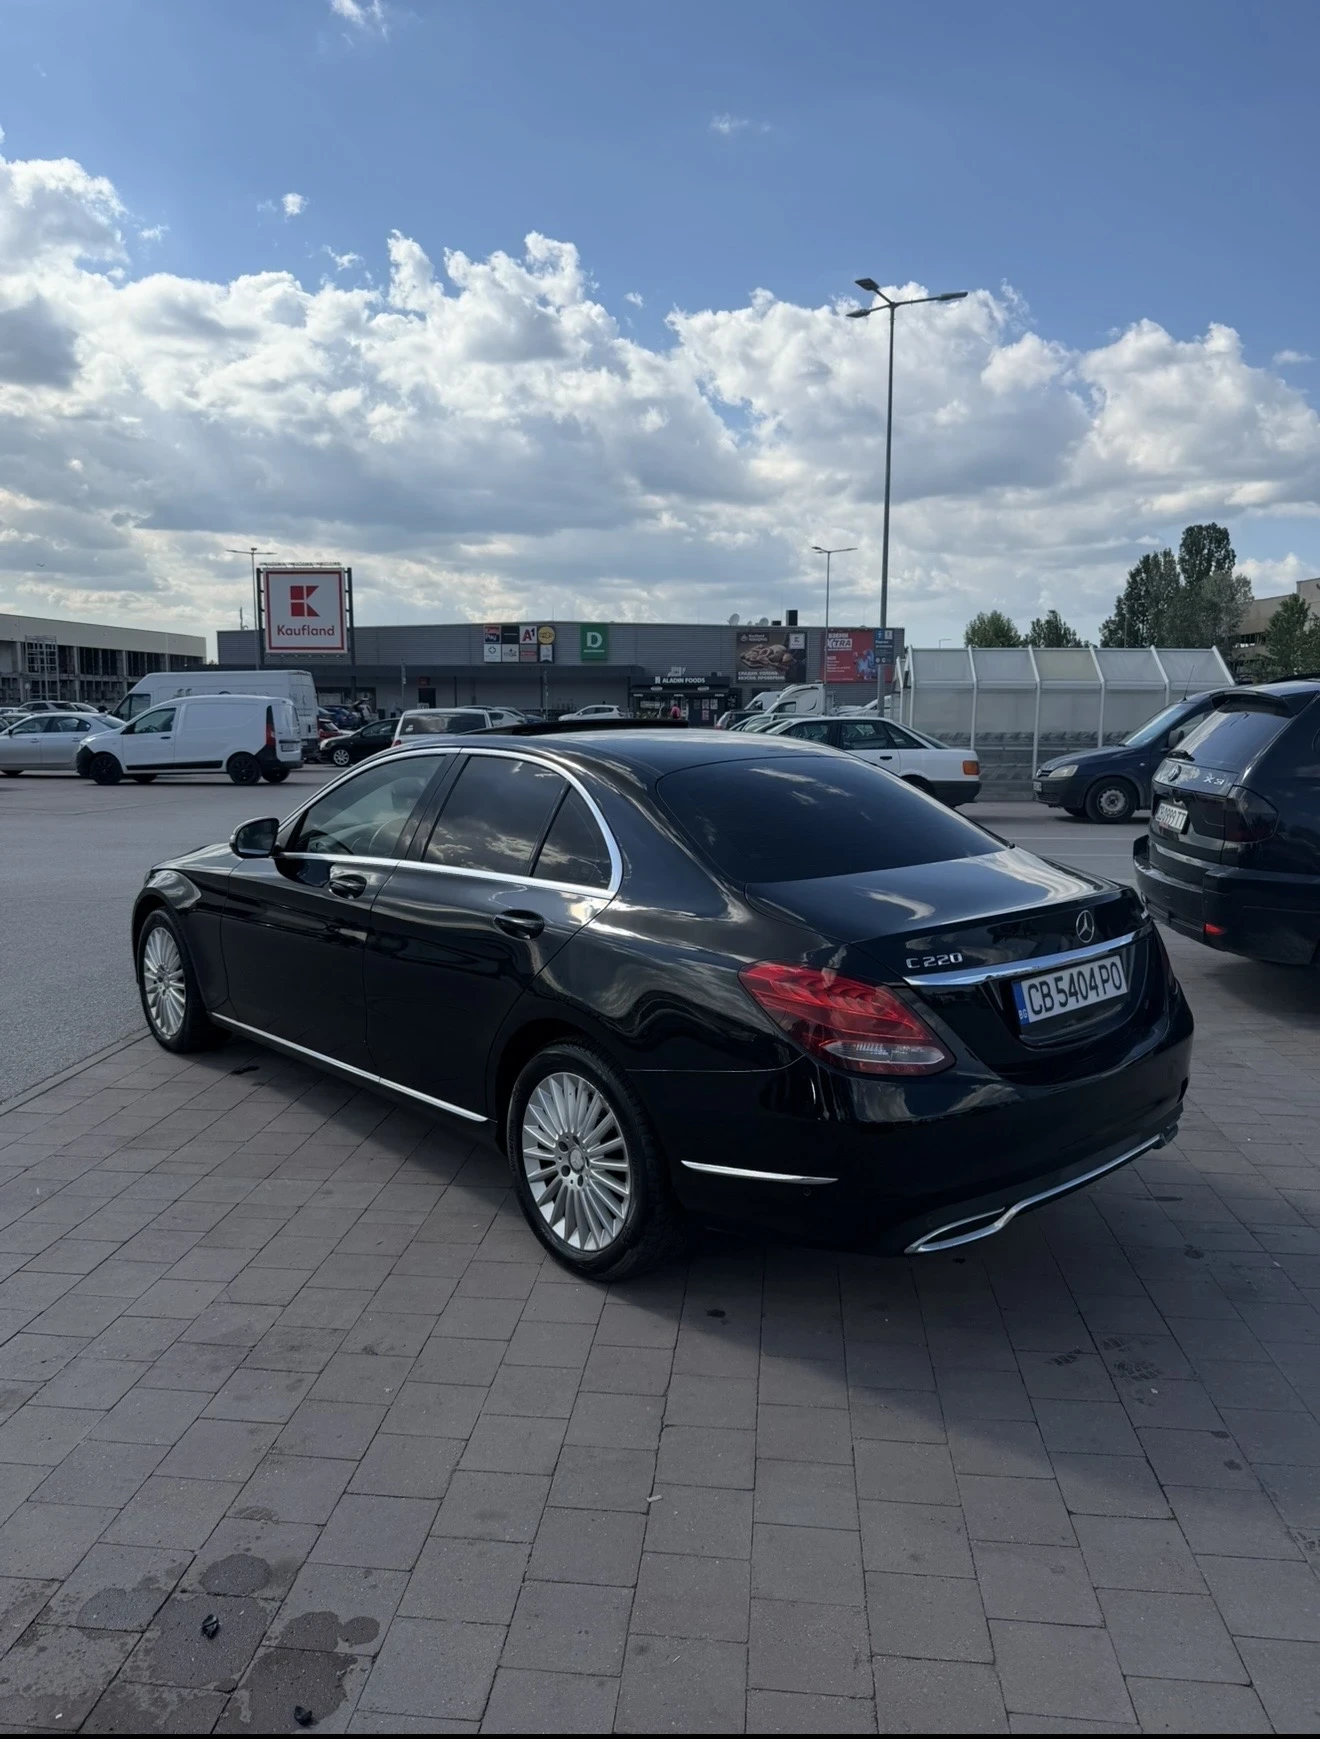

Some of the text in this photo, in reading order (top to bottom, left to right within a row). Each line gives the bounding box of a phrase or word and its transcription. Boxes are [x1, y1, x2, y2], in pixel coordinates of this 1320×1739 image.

[277, 625, 335, 636] Kaufland
[523, 628, 535, 642] A1
[586, 632, 603, 648] D
[827, 638, 851, 648] XTRA
[905, 952, 963, 969] C 220
[1027, 961, 1123, 1016] CB 5404 PO
[1019, 1008, 1028, 1020] BG
